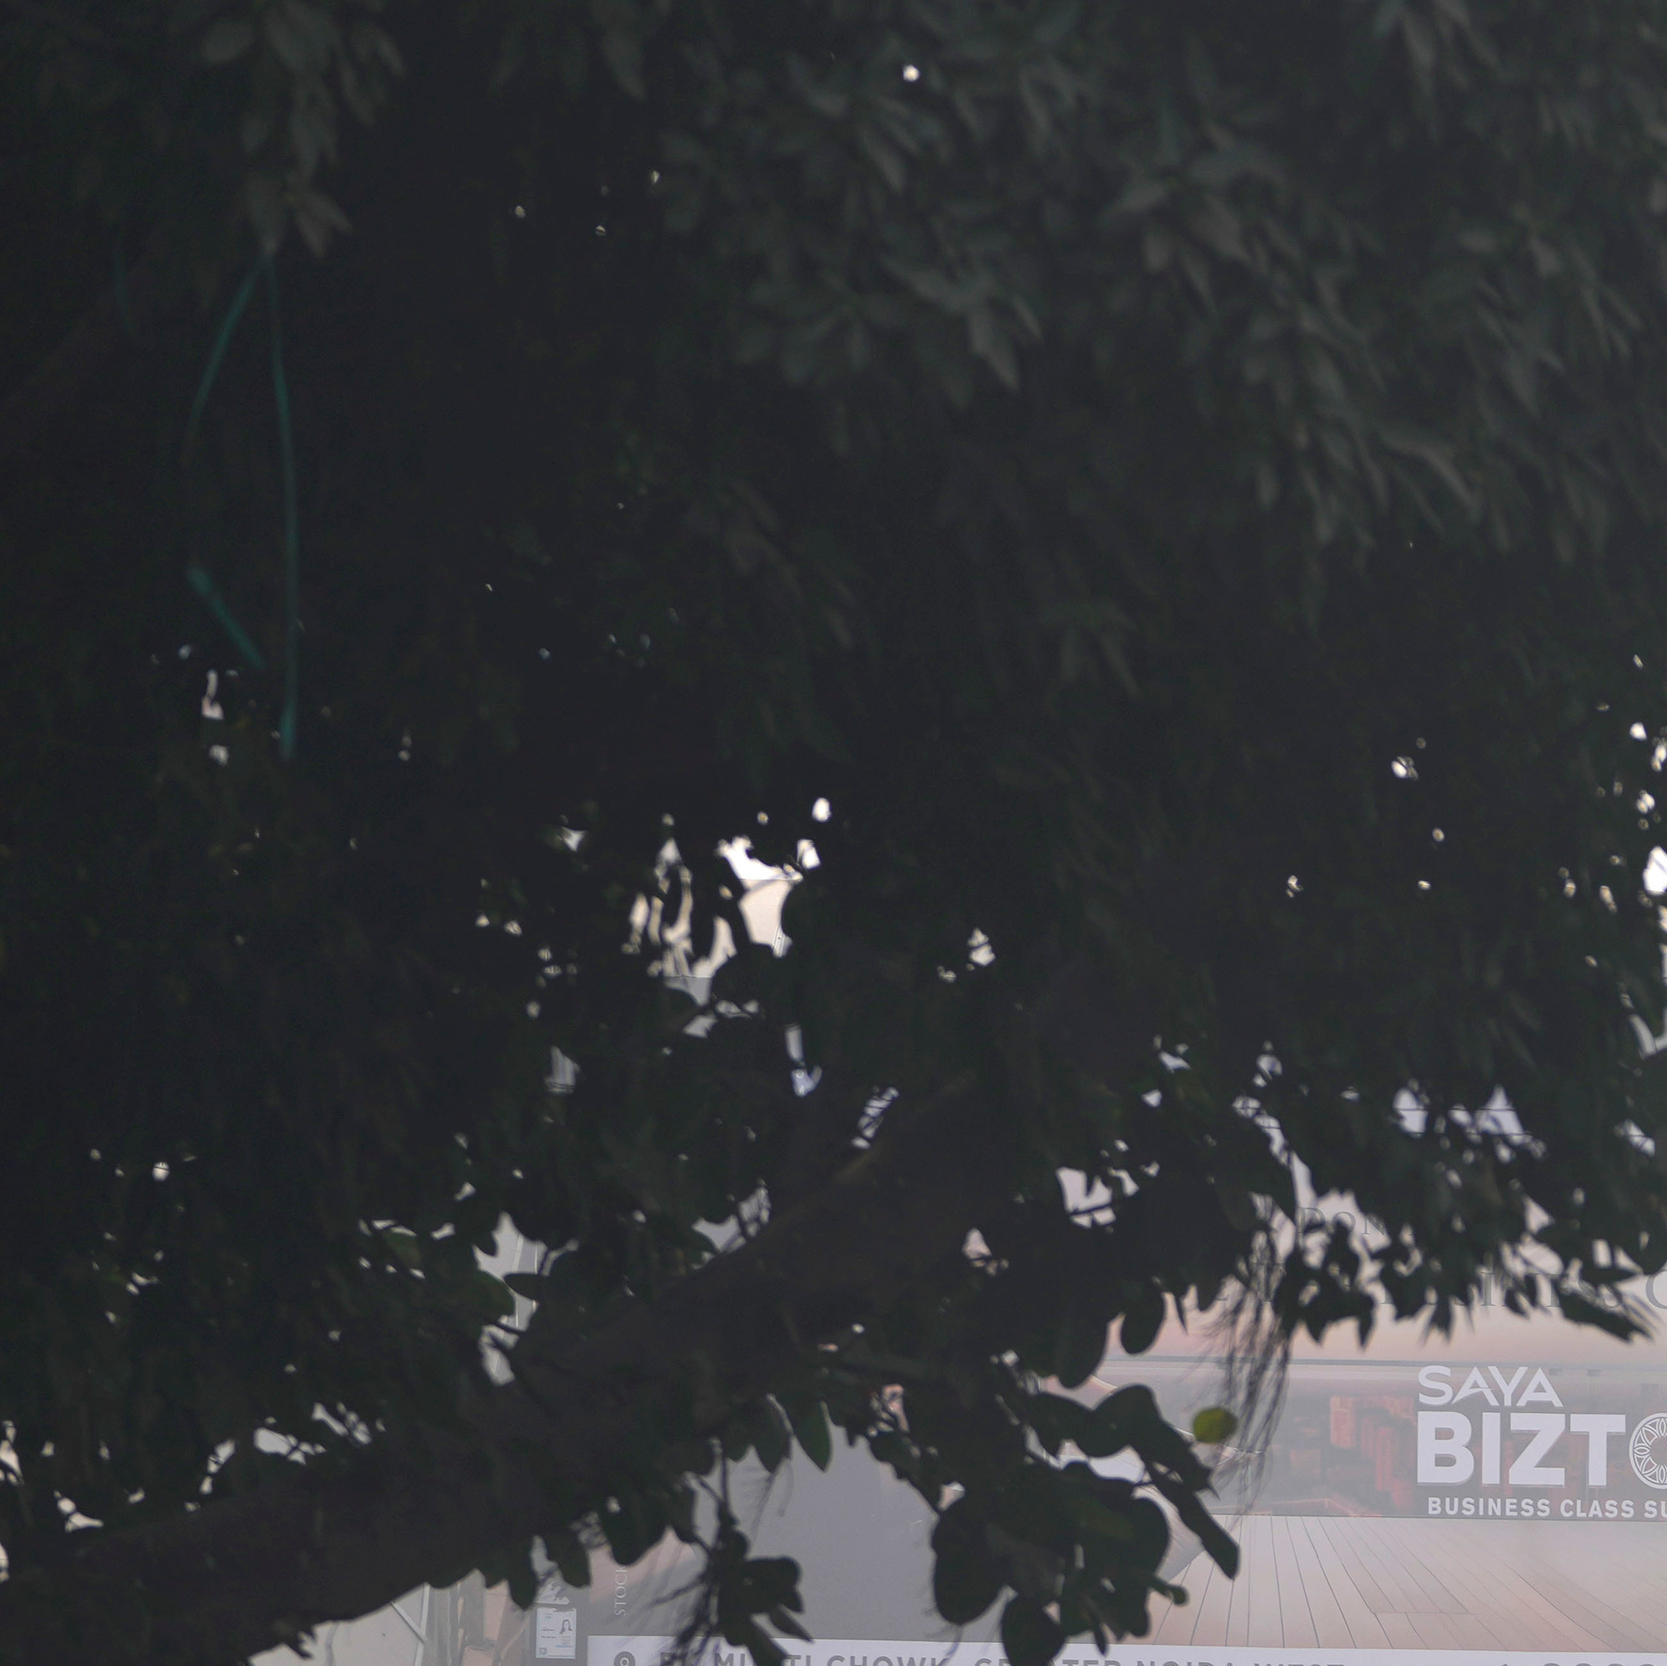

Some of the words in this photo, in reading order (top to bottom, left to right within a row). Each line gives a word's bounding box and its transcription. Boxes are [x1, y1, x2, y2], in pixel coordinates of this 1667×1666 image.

[1417, 1365, 1564, 1407] SAYA
[1427, 1496, 1552, 1518] BUSINESS
[1559, 1498, 1636, 1519] CLASS
